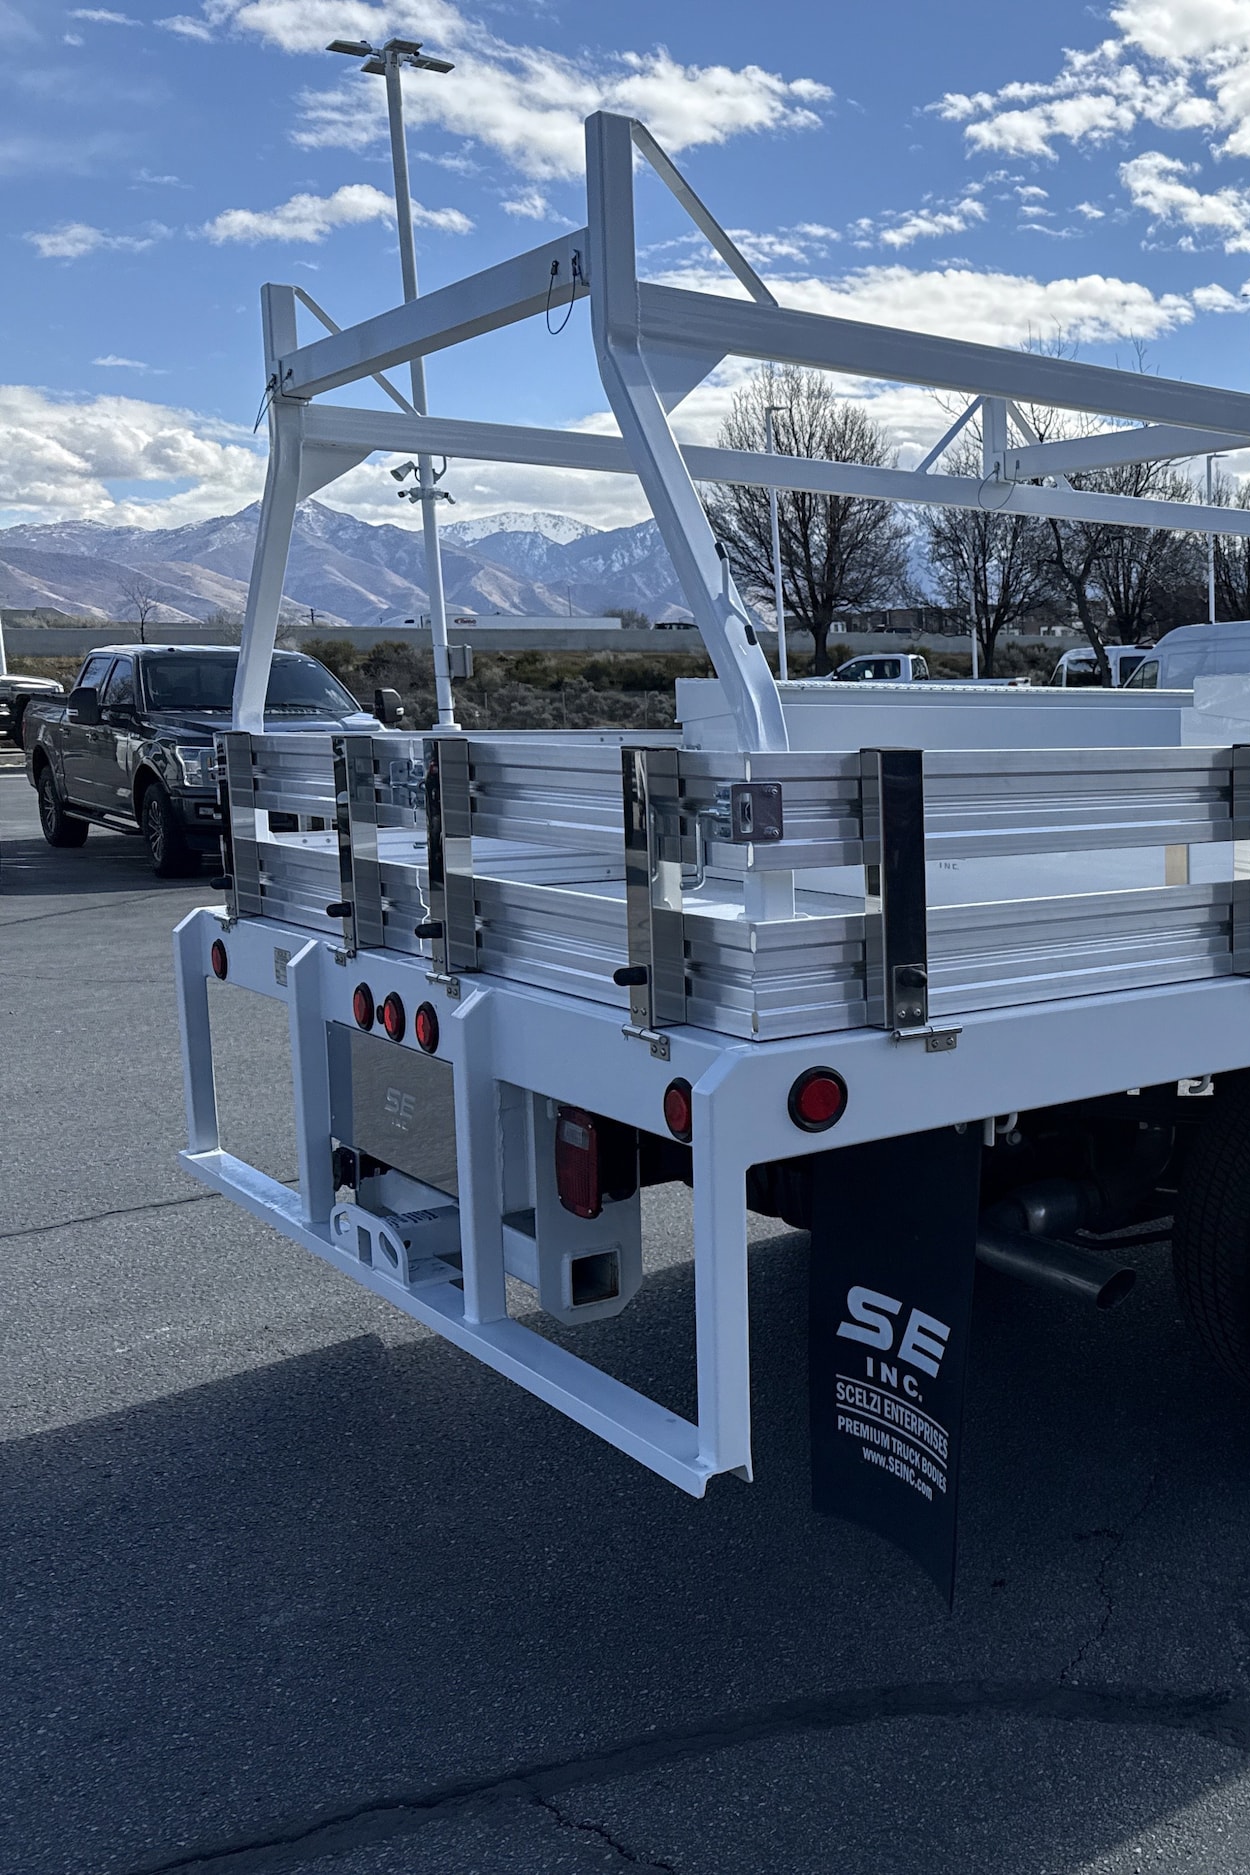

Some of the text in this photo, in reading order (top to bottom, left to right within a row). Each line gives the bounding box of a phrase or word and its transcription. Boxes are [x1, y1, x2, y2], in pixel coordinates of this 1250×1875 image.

[384, 1087, 417, 1120] SE
[836, 1285, 951, 1379] SE
[866, 1356, 923, 1403] INC.
[836, 1381, 948, 1460] SCELZI ENTERPRISES
[838, 1415, 947, 1494] PREMIUM TRUCK BODIES
[862, 1446, 933, 1502] www.SEINC.com
